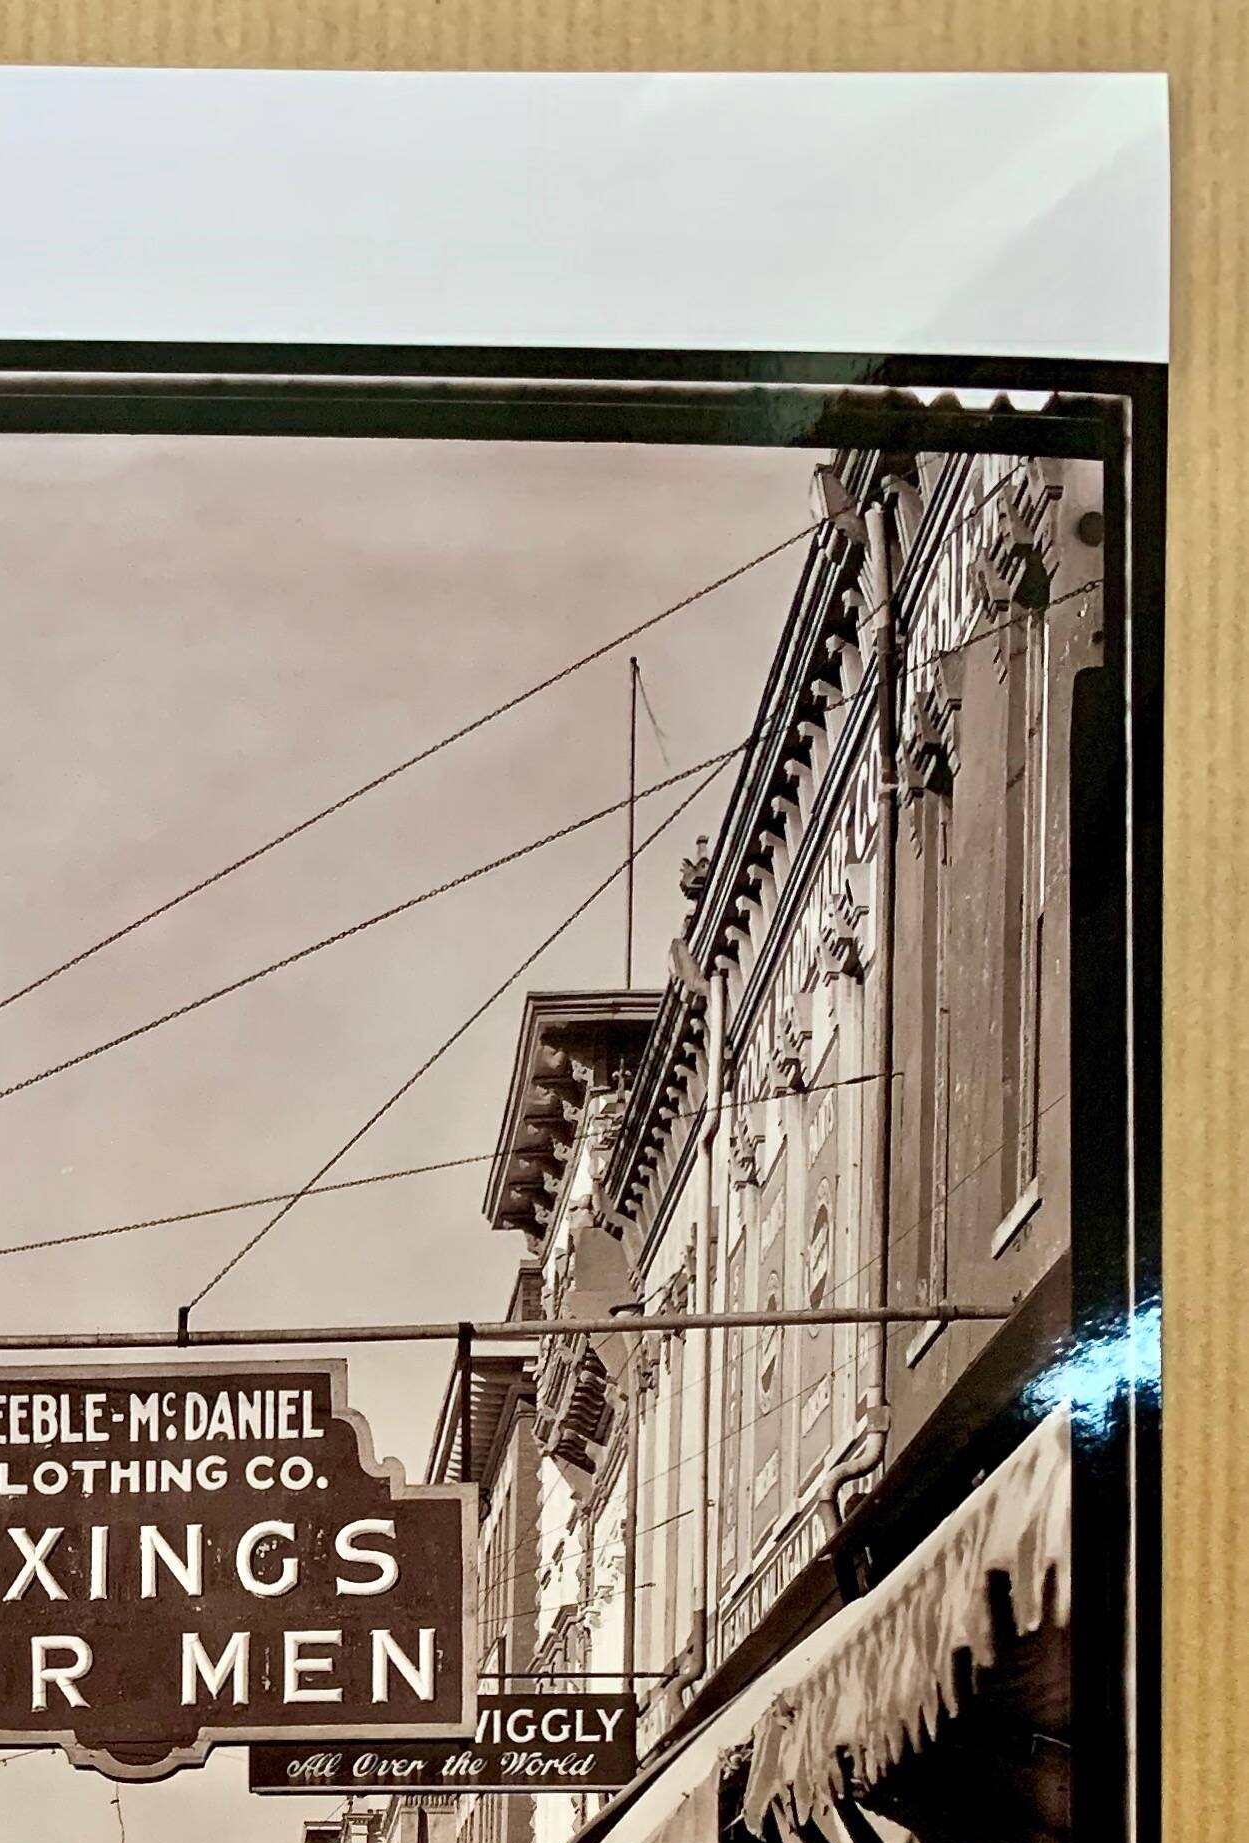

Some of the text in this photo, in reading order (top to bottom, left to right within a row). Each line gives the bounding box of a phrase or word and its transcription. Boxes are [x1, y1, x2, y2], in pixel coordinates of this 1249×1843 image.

[244, 1455, 330, 1491] CO.
[180, 1627, 438, 1706] MEN
[287, 1750, 597, 1778] All Over the World
